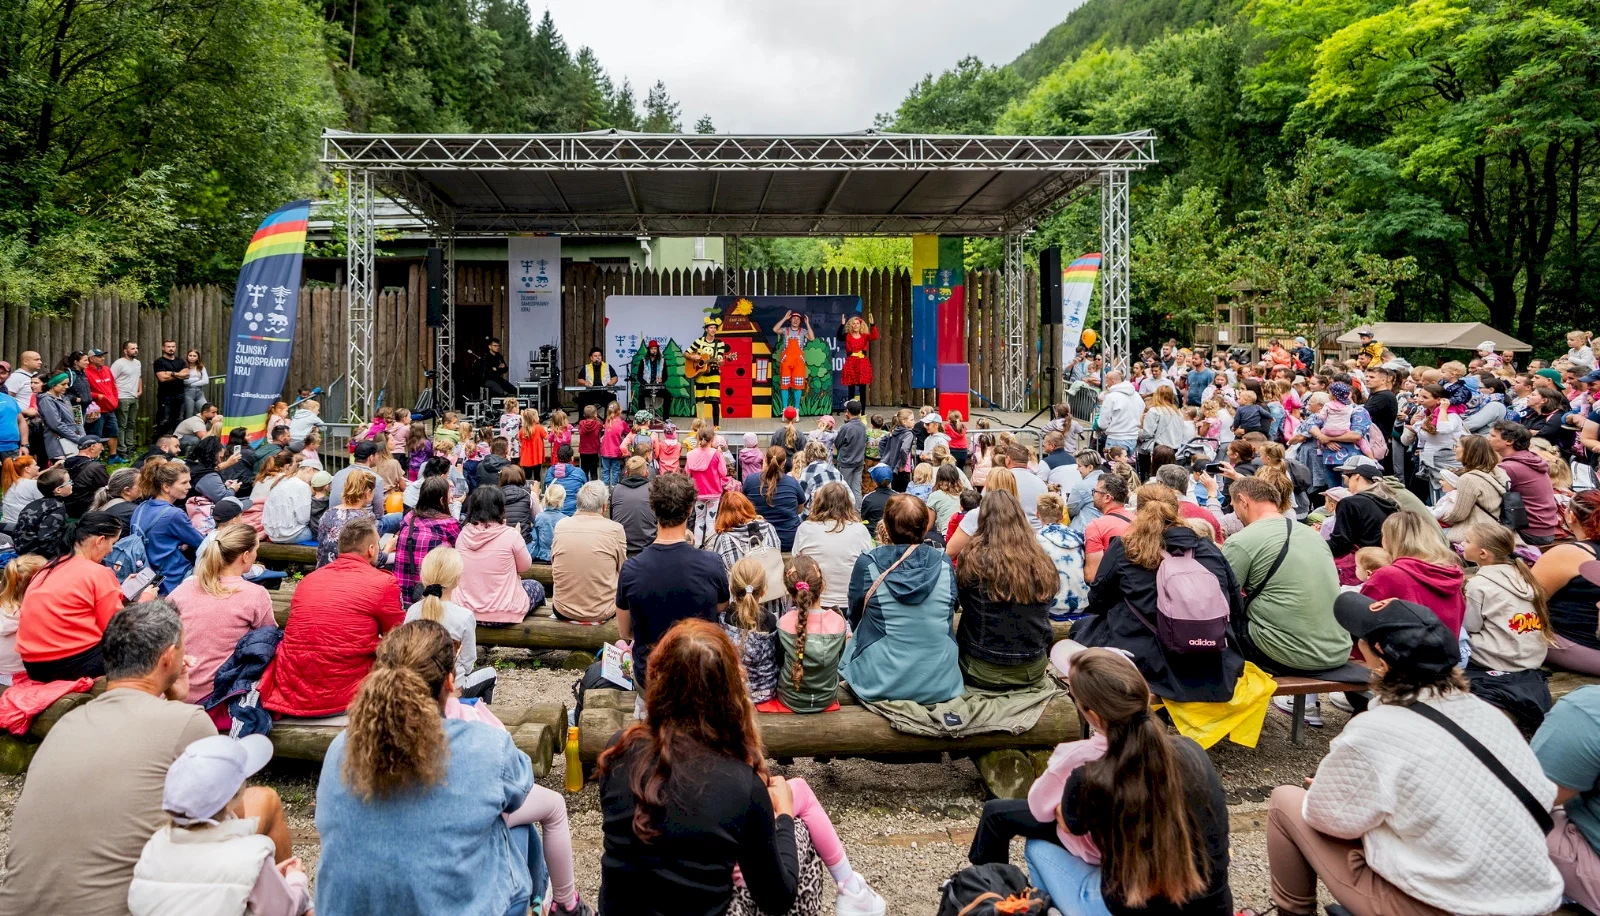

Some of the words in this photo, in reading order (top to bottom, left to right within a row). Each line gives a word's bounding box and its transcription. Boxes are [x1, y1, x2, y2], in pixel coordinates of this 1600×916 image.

[235, 341, 268, 355] ŽILINSKÝ
[234, 354, 290, 367] SAMOSPRÁVNY
[233, 365, 251, 376] KRAJ
[1189, 638, 1216, 646] adidas
